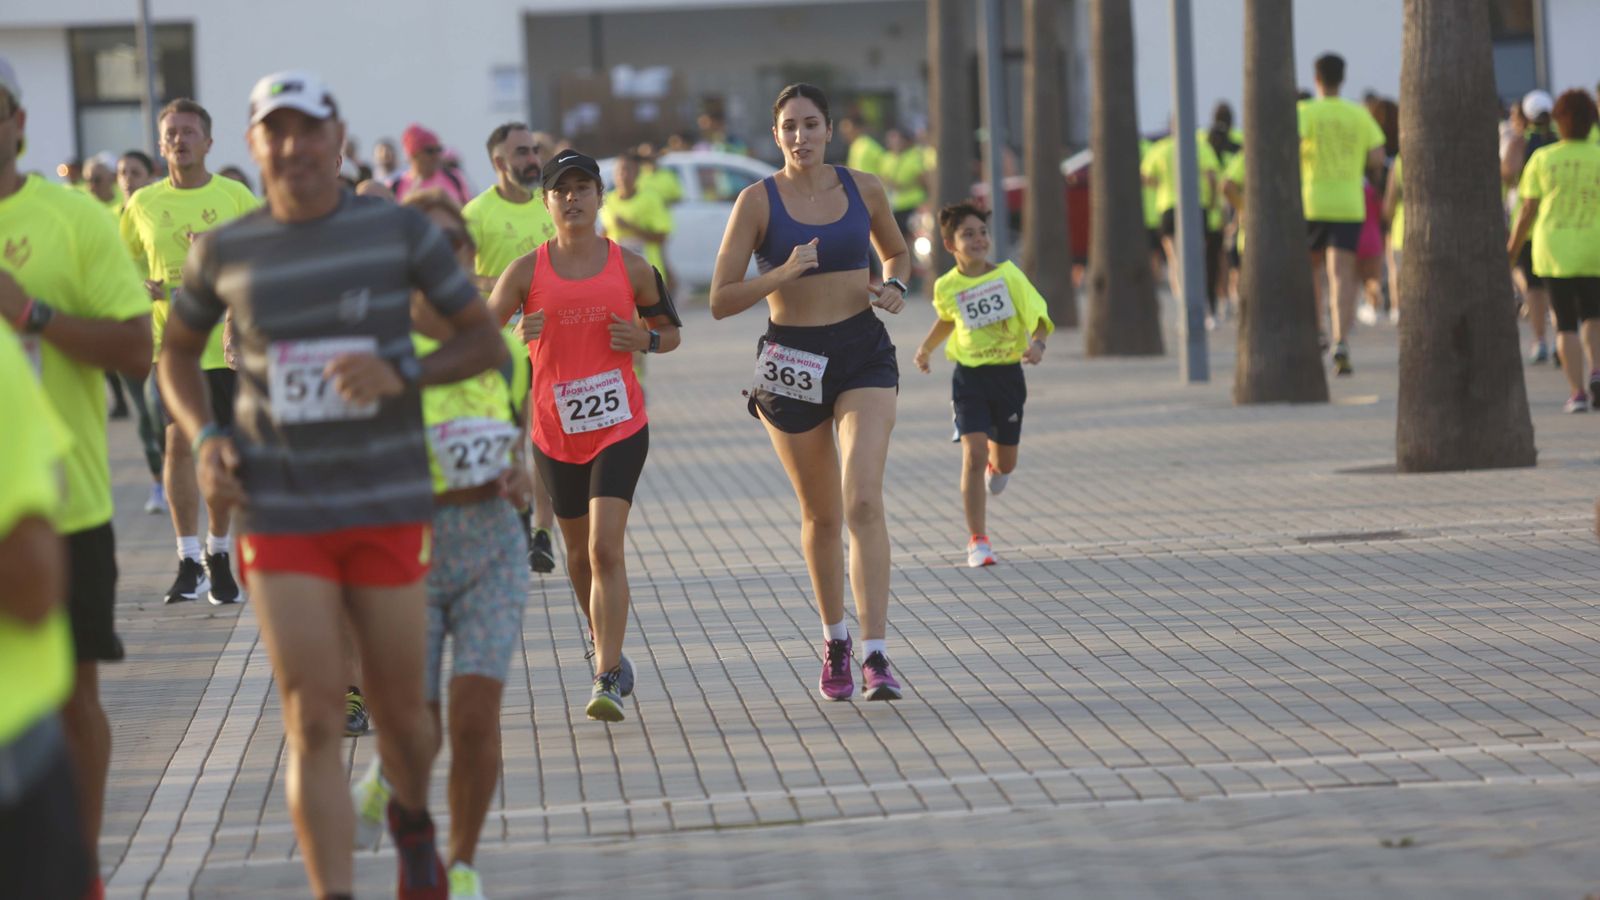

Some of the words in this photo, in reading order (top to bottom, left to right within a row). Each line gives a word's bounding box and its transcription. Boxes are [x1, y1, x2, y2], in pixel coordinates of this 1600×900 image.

[966, 294, 1004, 319] 563
[764, 361, 812, 390] 363
[566, 389, 619, 421] 225
[448, 435, 511, 470] 227
